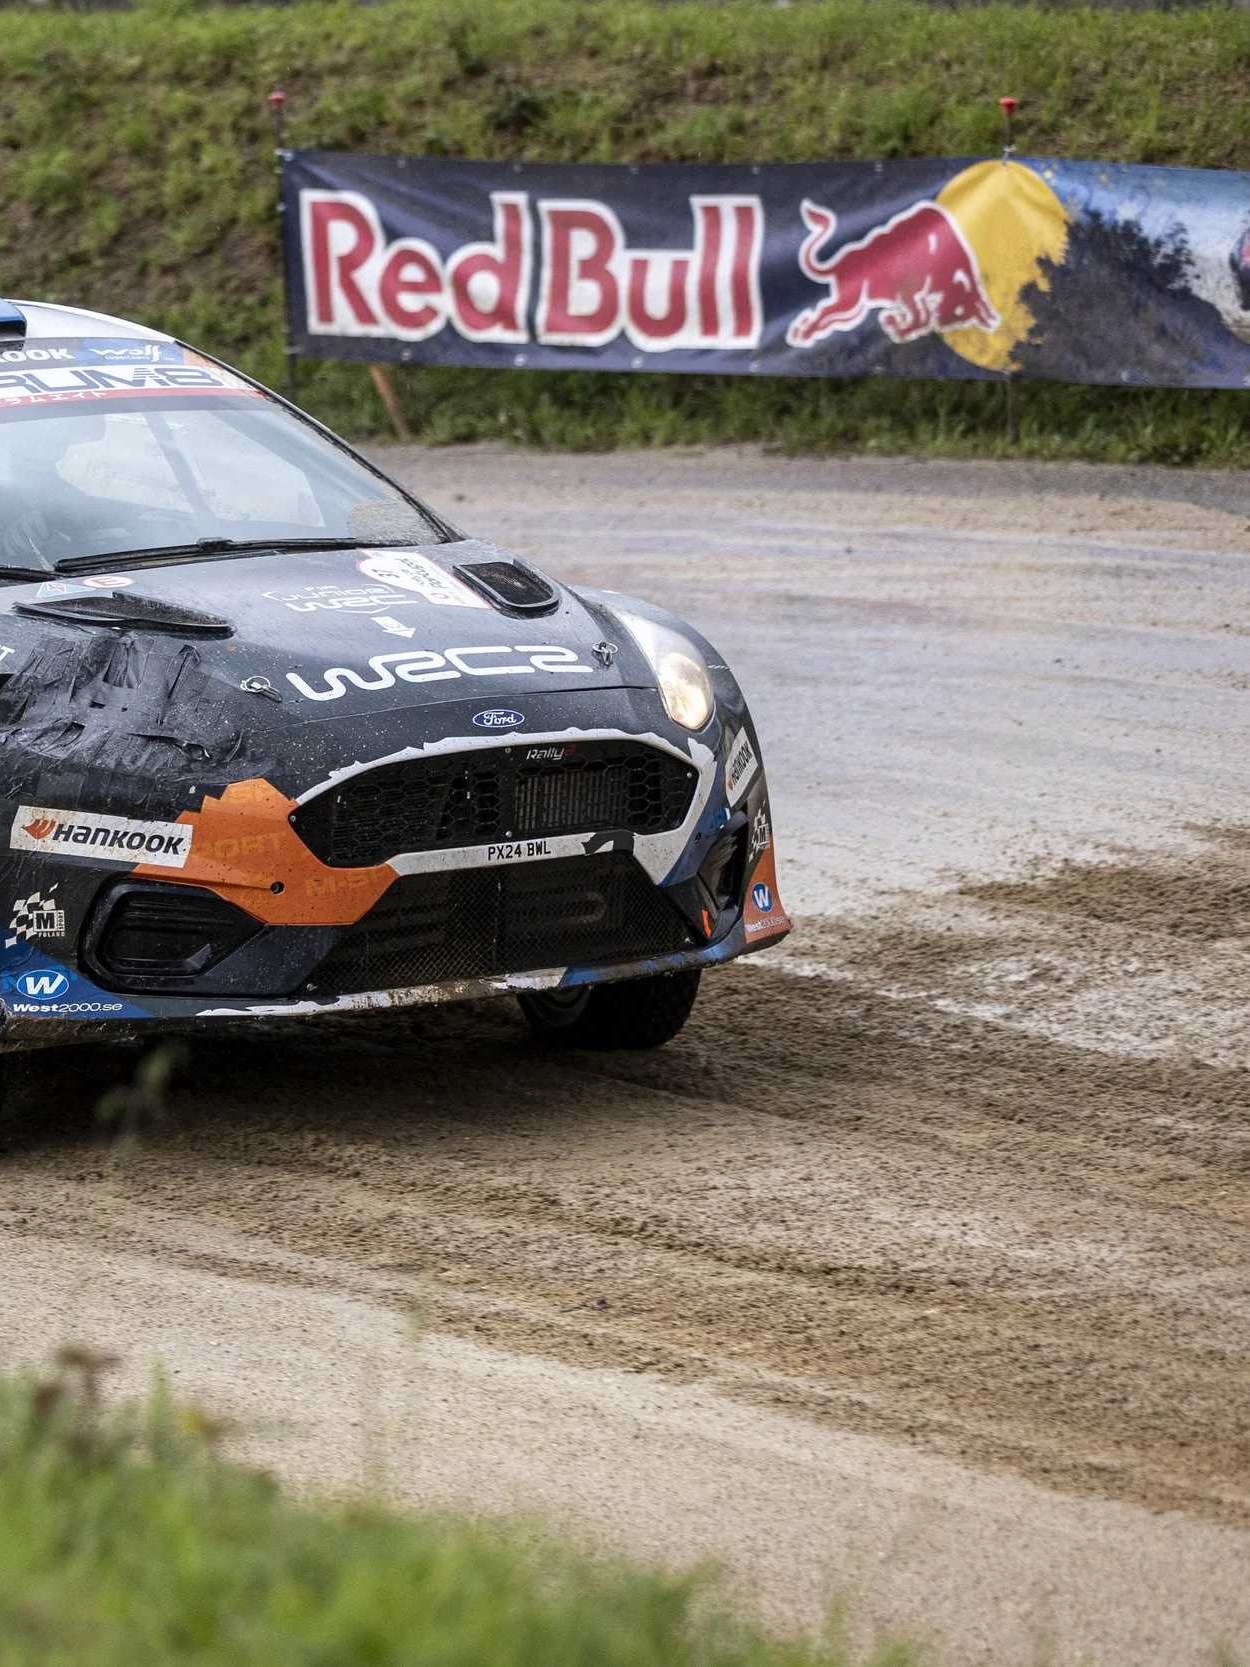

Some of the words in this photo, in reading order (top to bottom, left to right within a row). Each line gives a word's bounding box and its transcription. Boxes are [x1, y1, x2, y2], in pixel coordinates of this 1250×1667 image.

[298, 187, 529, 341] Red
[537, 194, 763, 351] Bull
[285, 594, 418, 612] WRC
[286, 645, 594, 701] WRC2
[483, 711, 517, 726] Ford
[488, 843, 522, 861] PX24
[527, 840, 551, 857] BWL
[753, 884, 769, 909] W
[36, 912, 55, 930] M
[25, 973, 66, 995] W
[12, 1002, 123, 1013] West2000.se
